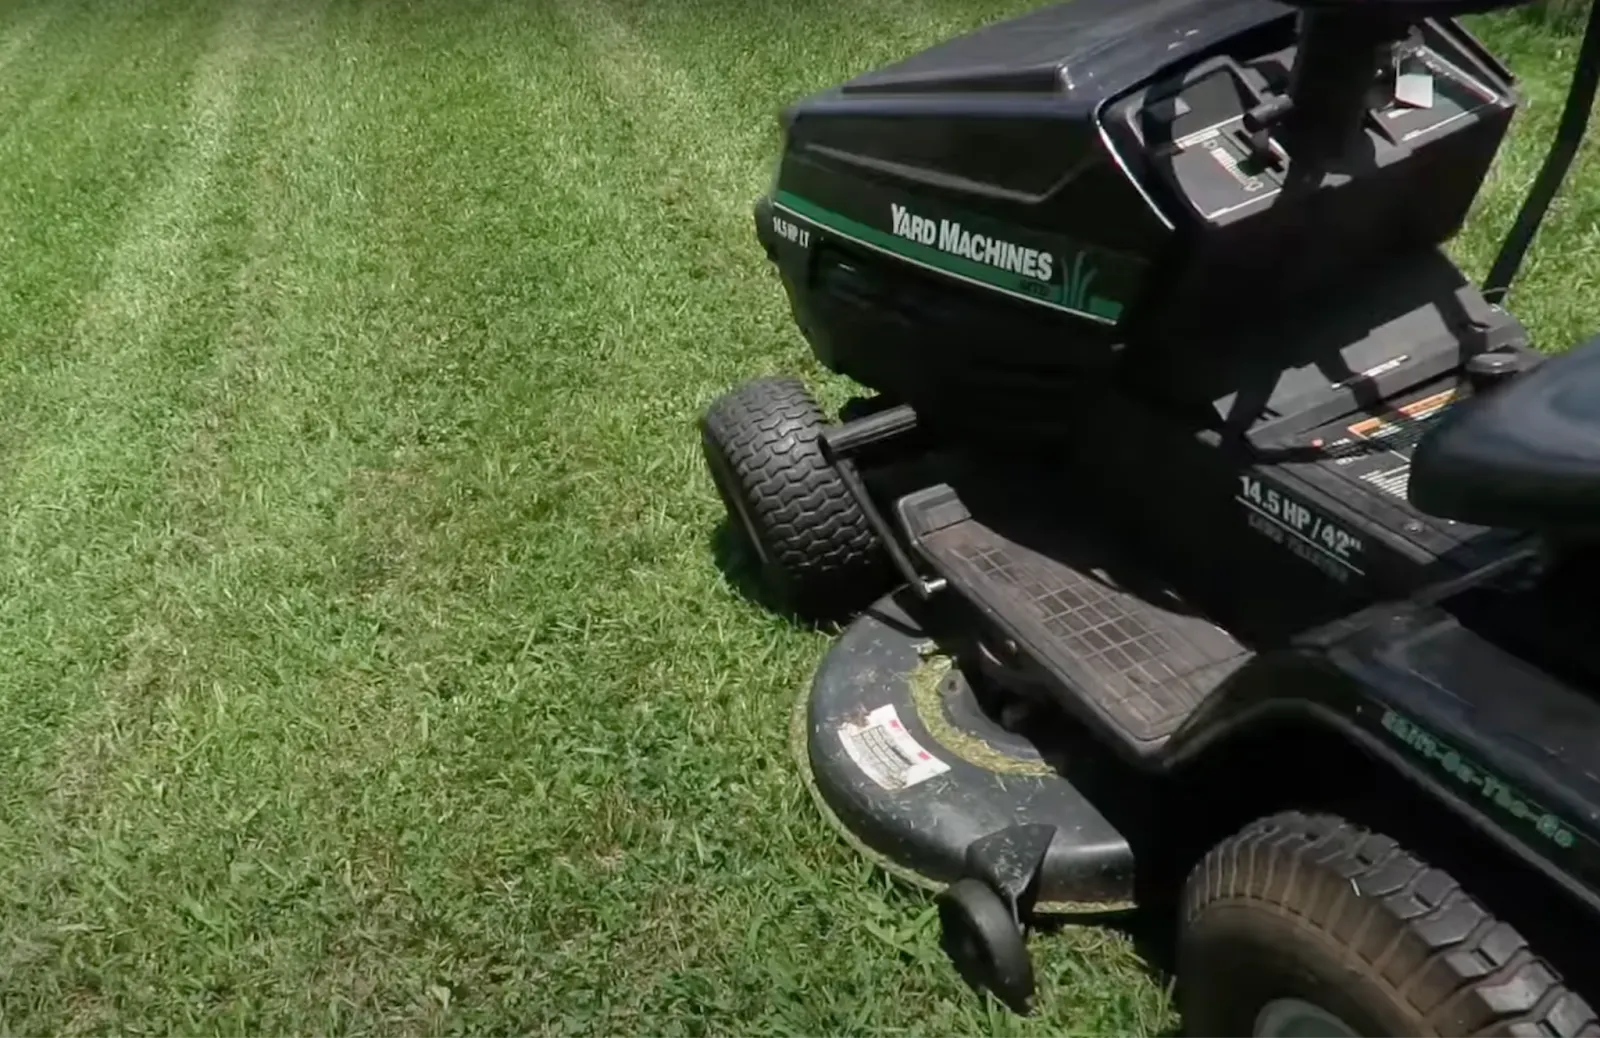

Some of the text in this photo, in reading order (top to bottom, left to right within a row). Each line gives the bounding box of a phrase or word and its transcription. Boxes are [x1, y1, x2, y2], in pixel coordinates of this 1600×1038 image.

[891, 203, 1053, 281] YARD MACHINES
[1239, 476, 1280, 515] 14.5
[1283, 498, 1311, 530] HP
